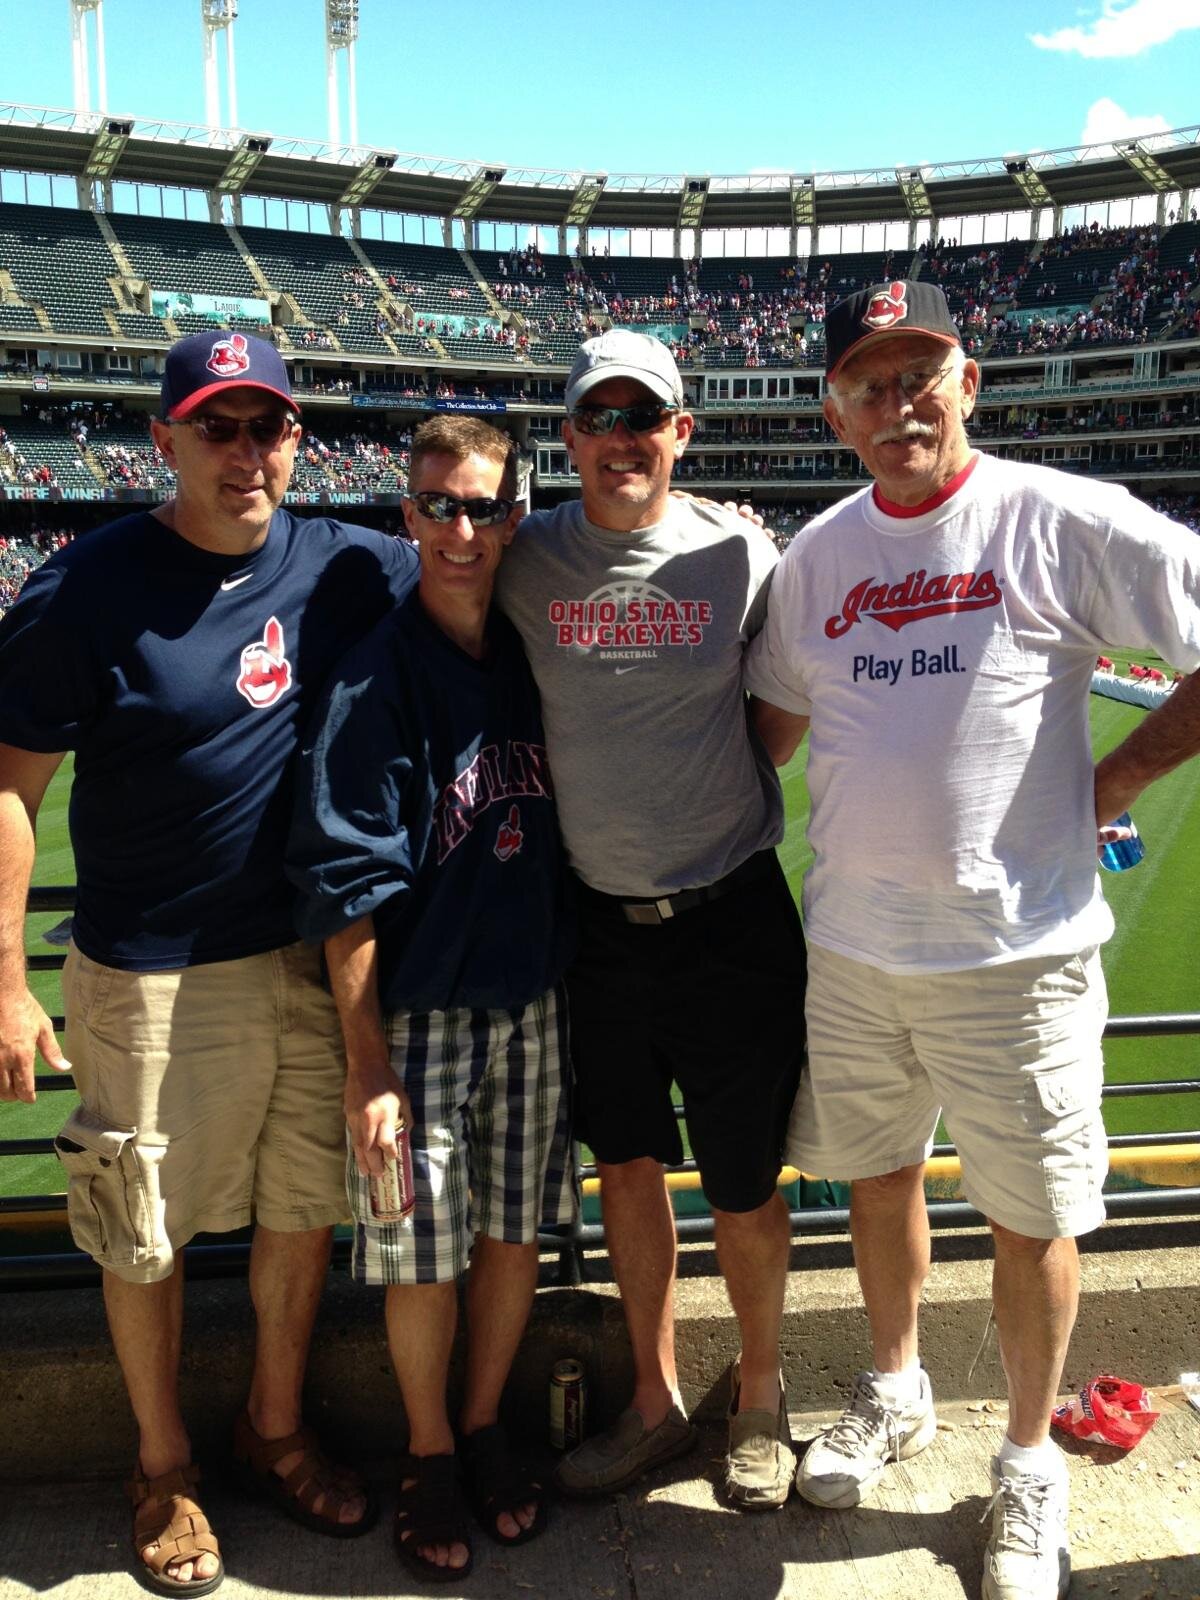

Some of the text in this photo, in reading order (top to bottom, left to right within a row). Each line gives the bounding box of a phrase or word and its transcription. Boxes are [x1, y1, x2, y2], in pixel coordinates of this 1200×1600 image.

[4, 486, 105, 501] TRIBE WINS!
[284, 491, 366, 505] TRIBE WINS!
[549, 600, 713, 625] OHIO STATE
[824, 569, 1003, 639] Indians
[556, 622, 704, 647] BUCKEYES
[600, 651, 658, 660] BASKETBALL
[852, 645, 967, 687] Play Ball.
[432, 741, 552, 866] INDIAN
